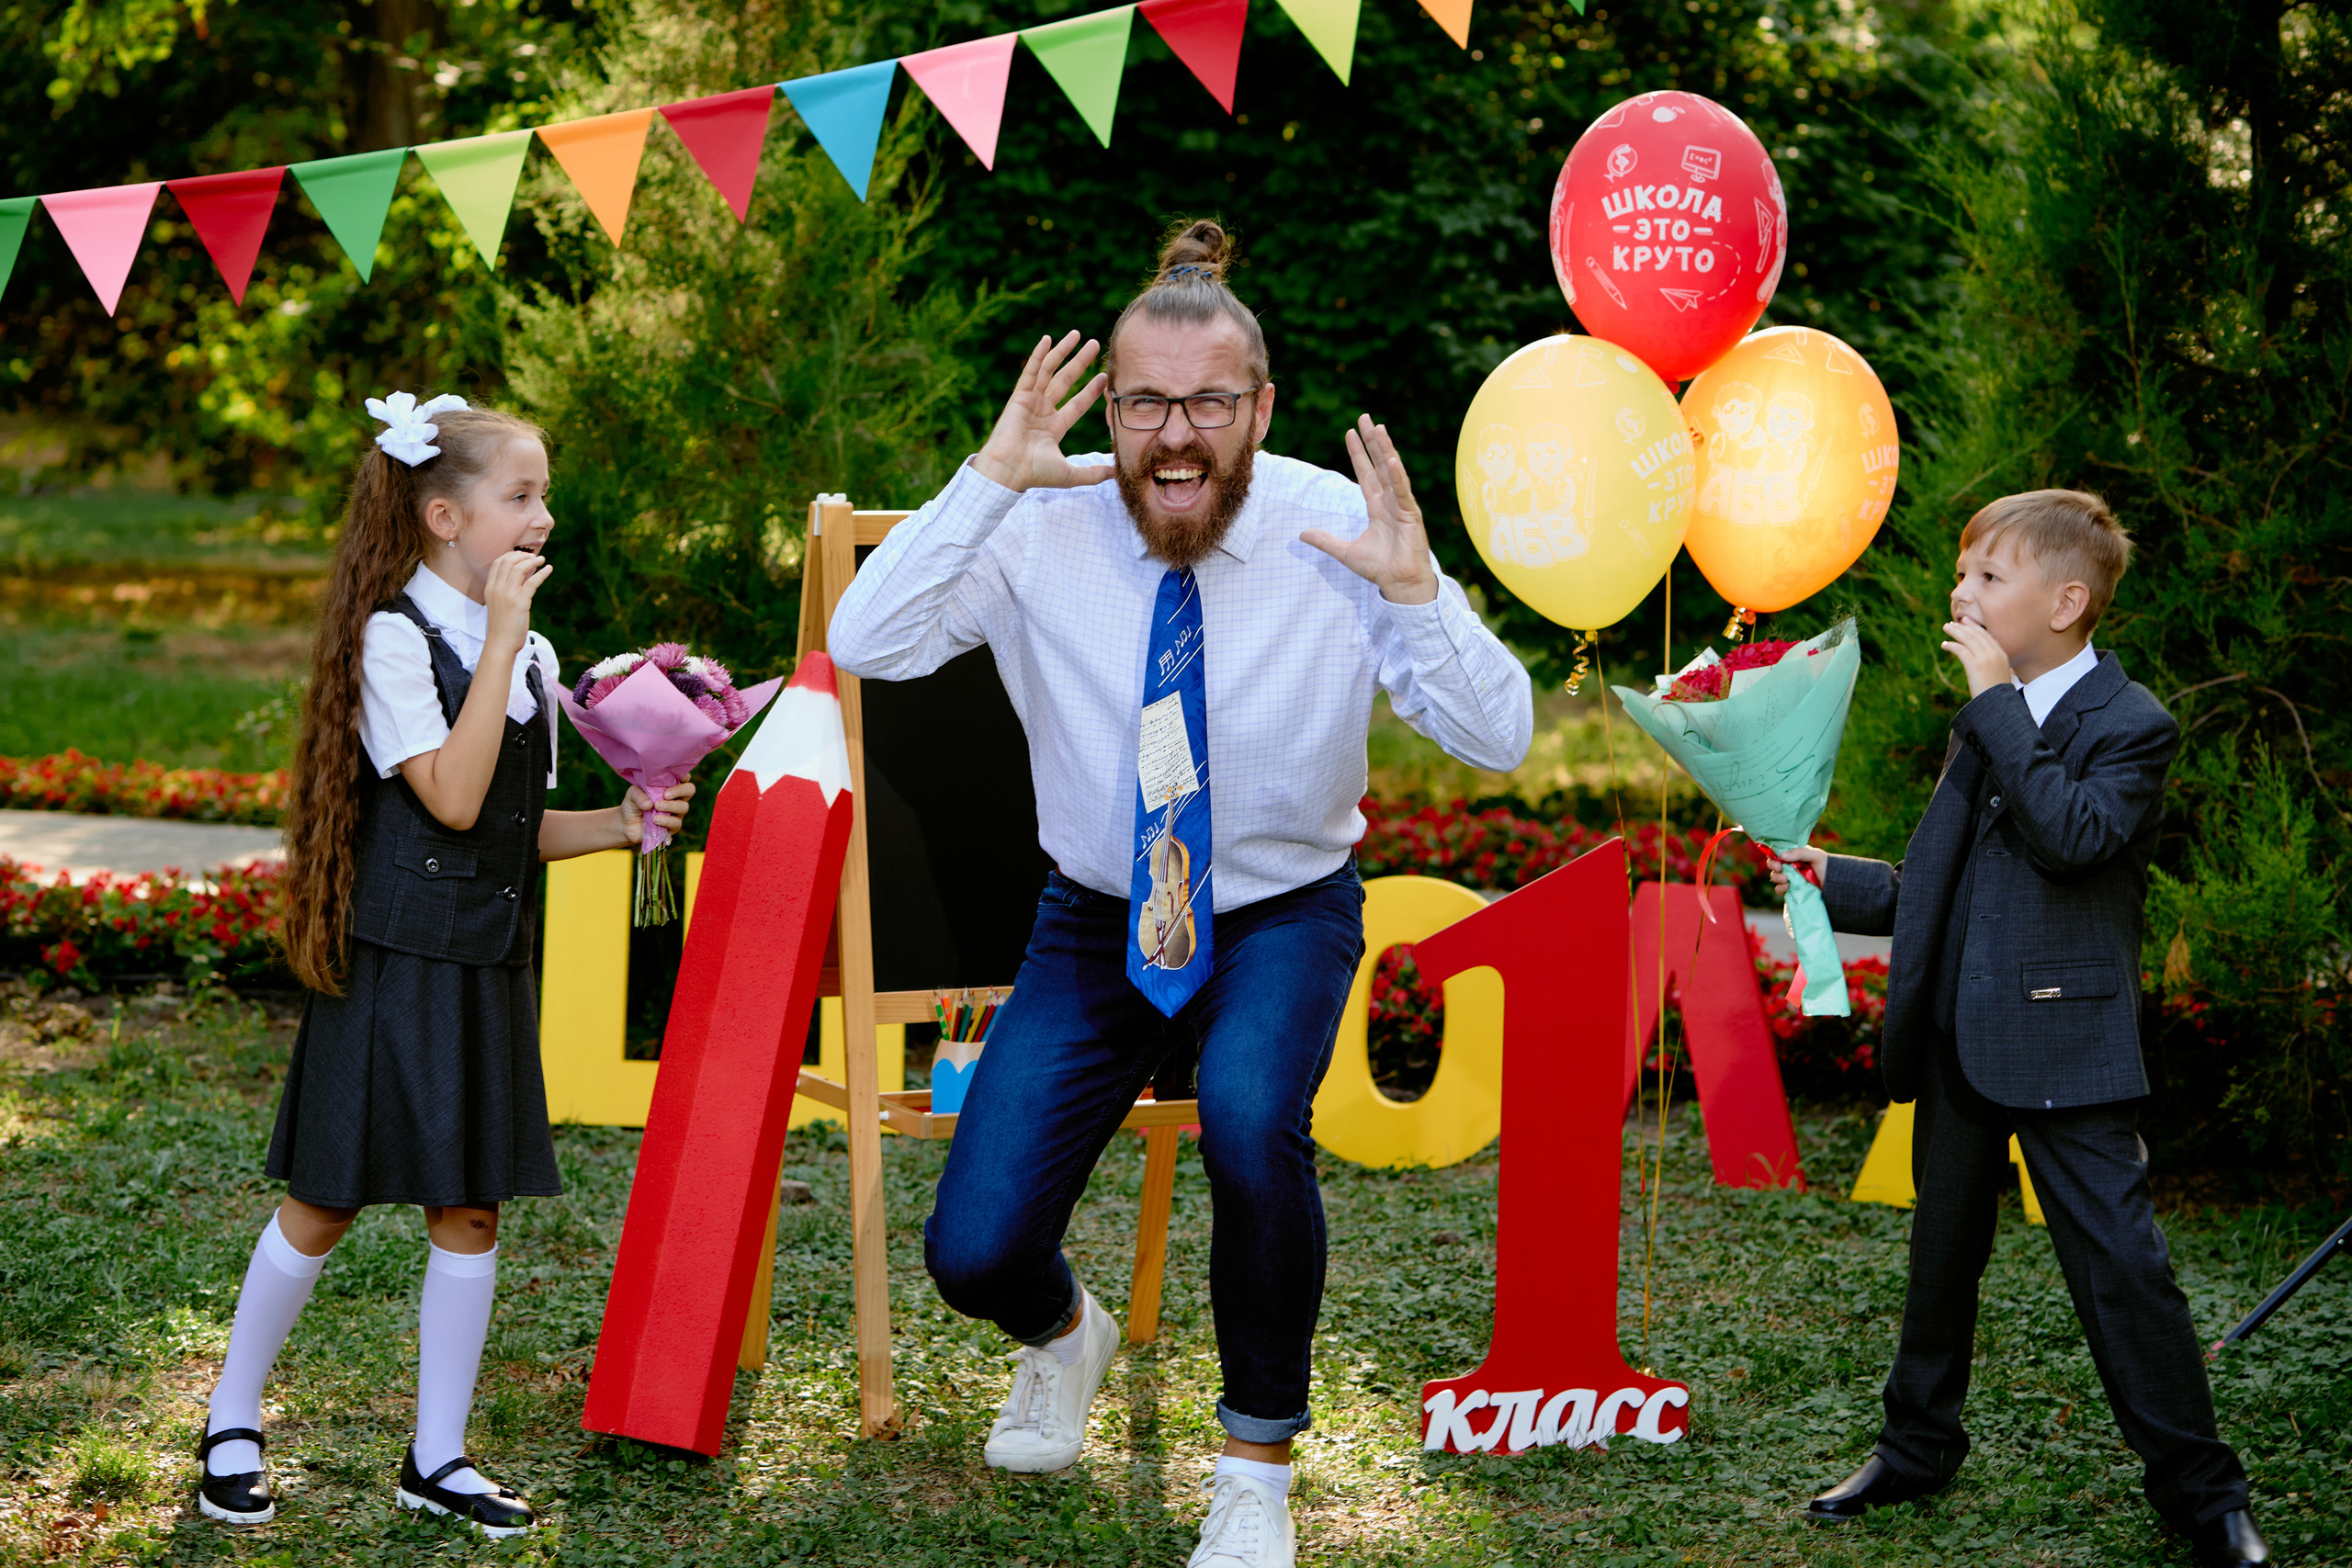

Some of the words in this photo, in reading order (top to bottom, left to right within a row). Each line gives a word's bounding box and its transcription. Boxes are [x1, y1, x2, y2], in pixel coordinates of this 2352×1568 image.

[1600, 184, 1723, 223] ШКОЛА
[1612, 245, 1714, 273] КРУТО
[1630, 431, 1694, 480] ШКОЛ
[1861, 444, 1899, 475] ШКО
[1648, 487, 1696, 525] КРУТ
[1695, 464, 1804, 528] АБВ
[1858, 498, 1891, 522] КРУ
[1488, 512, 1590, 569] АБВ
[1423, 1386, 1690, 1453] класс
